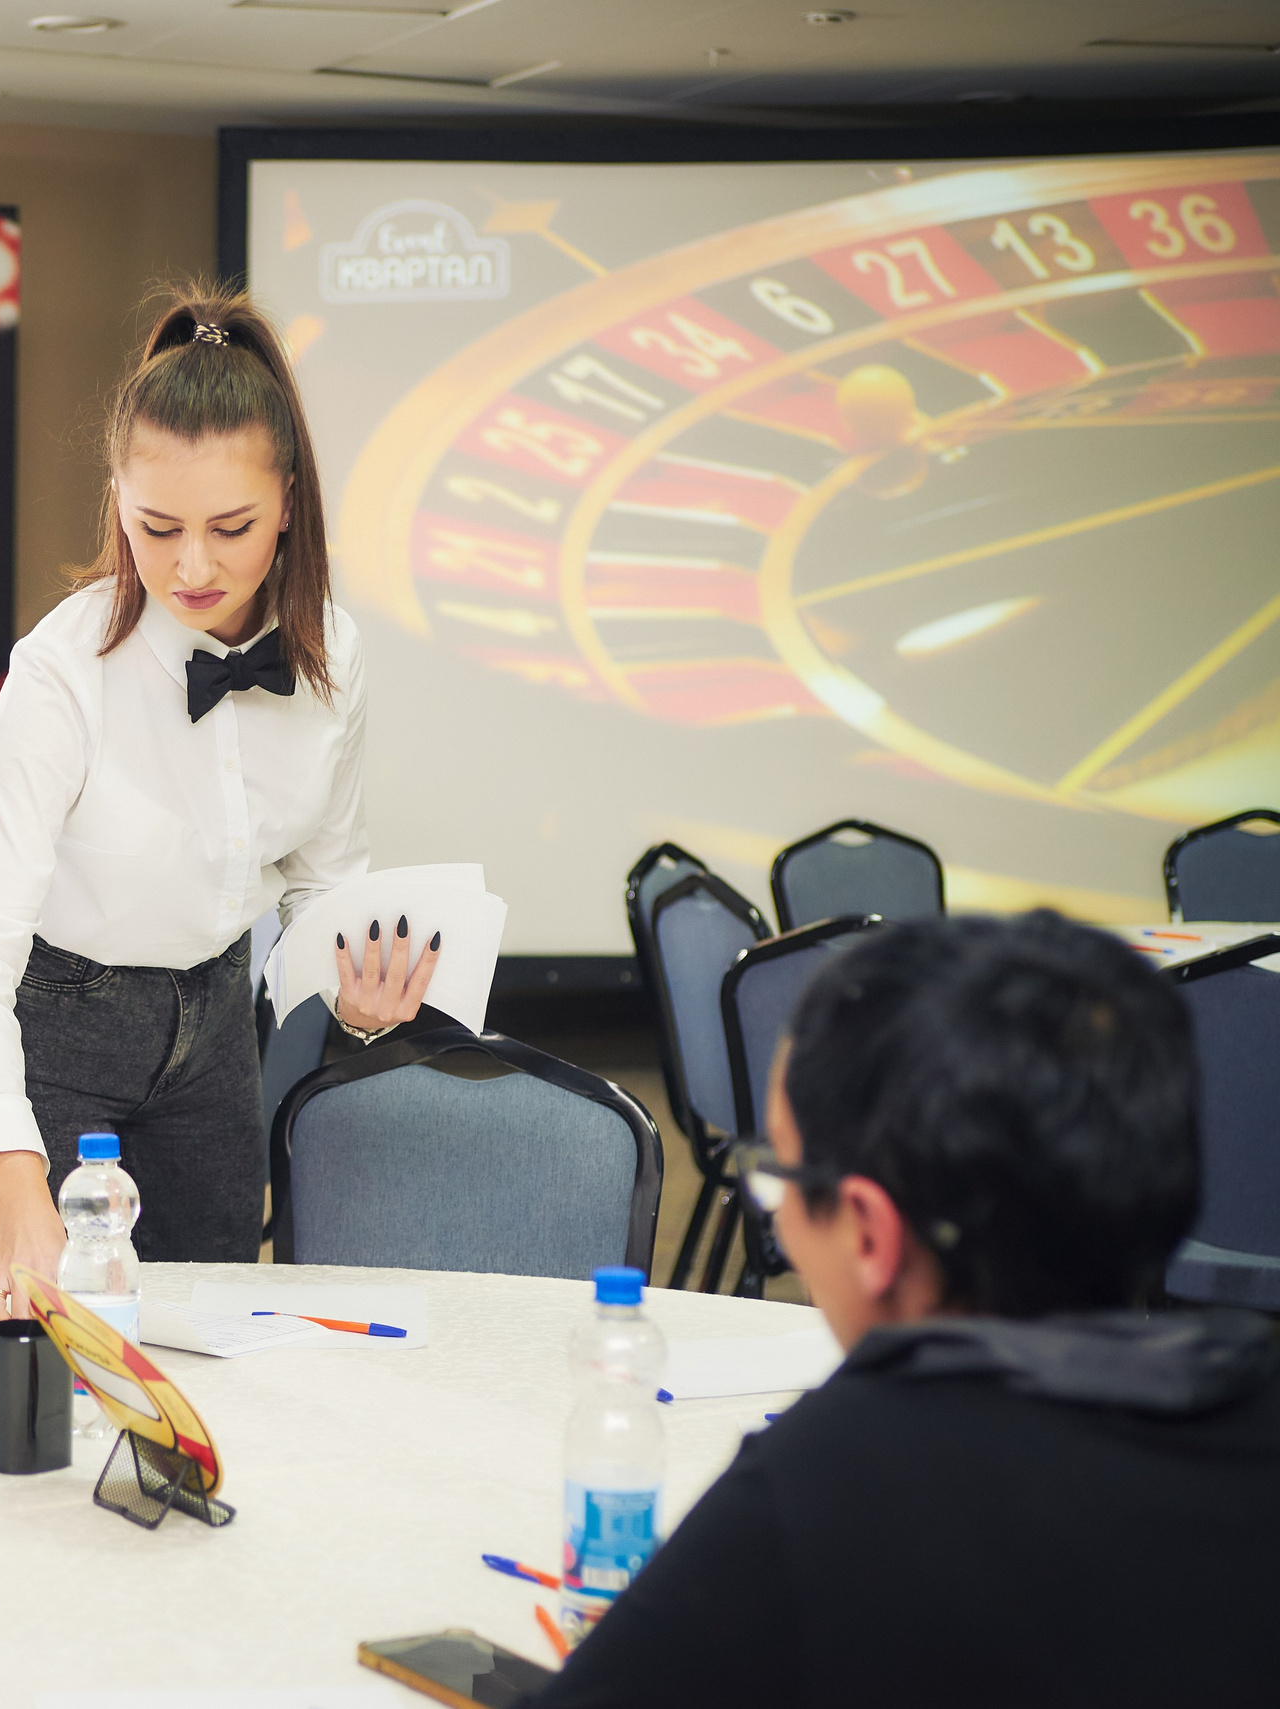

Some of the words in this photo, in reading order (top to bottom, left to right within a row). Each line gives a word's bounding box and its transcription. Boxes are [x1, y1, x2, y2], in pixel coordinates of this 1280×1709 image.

[991, 212, 1096, 279] 13
[1129, 193, 1236, 259] 36
[336, 253, 493, 290] КВАРТАЛ
[852, 237, 957, 308] 27
[749, 277, 835, 335] 6
[629, 311, 754, 378] 34
[547, 354, 665, 422] 17
